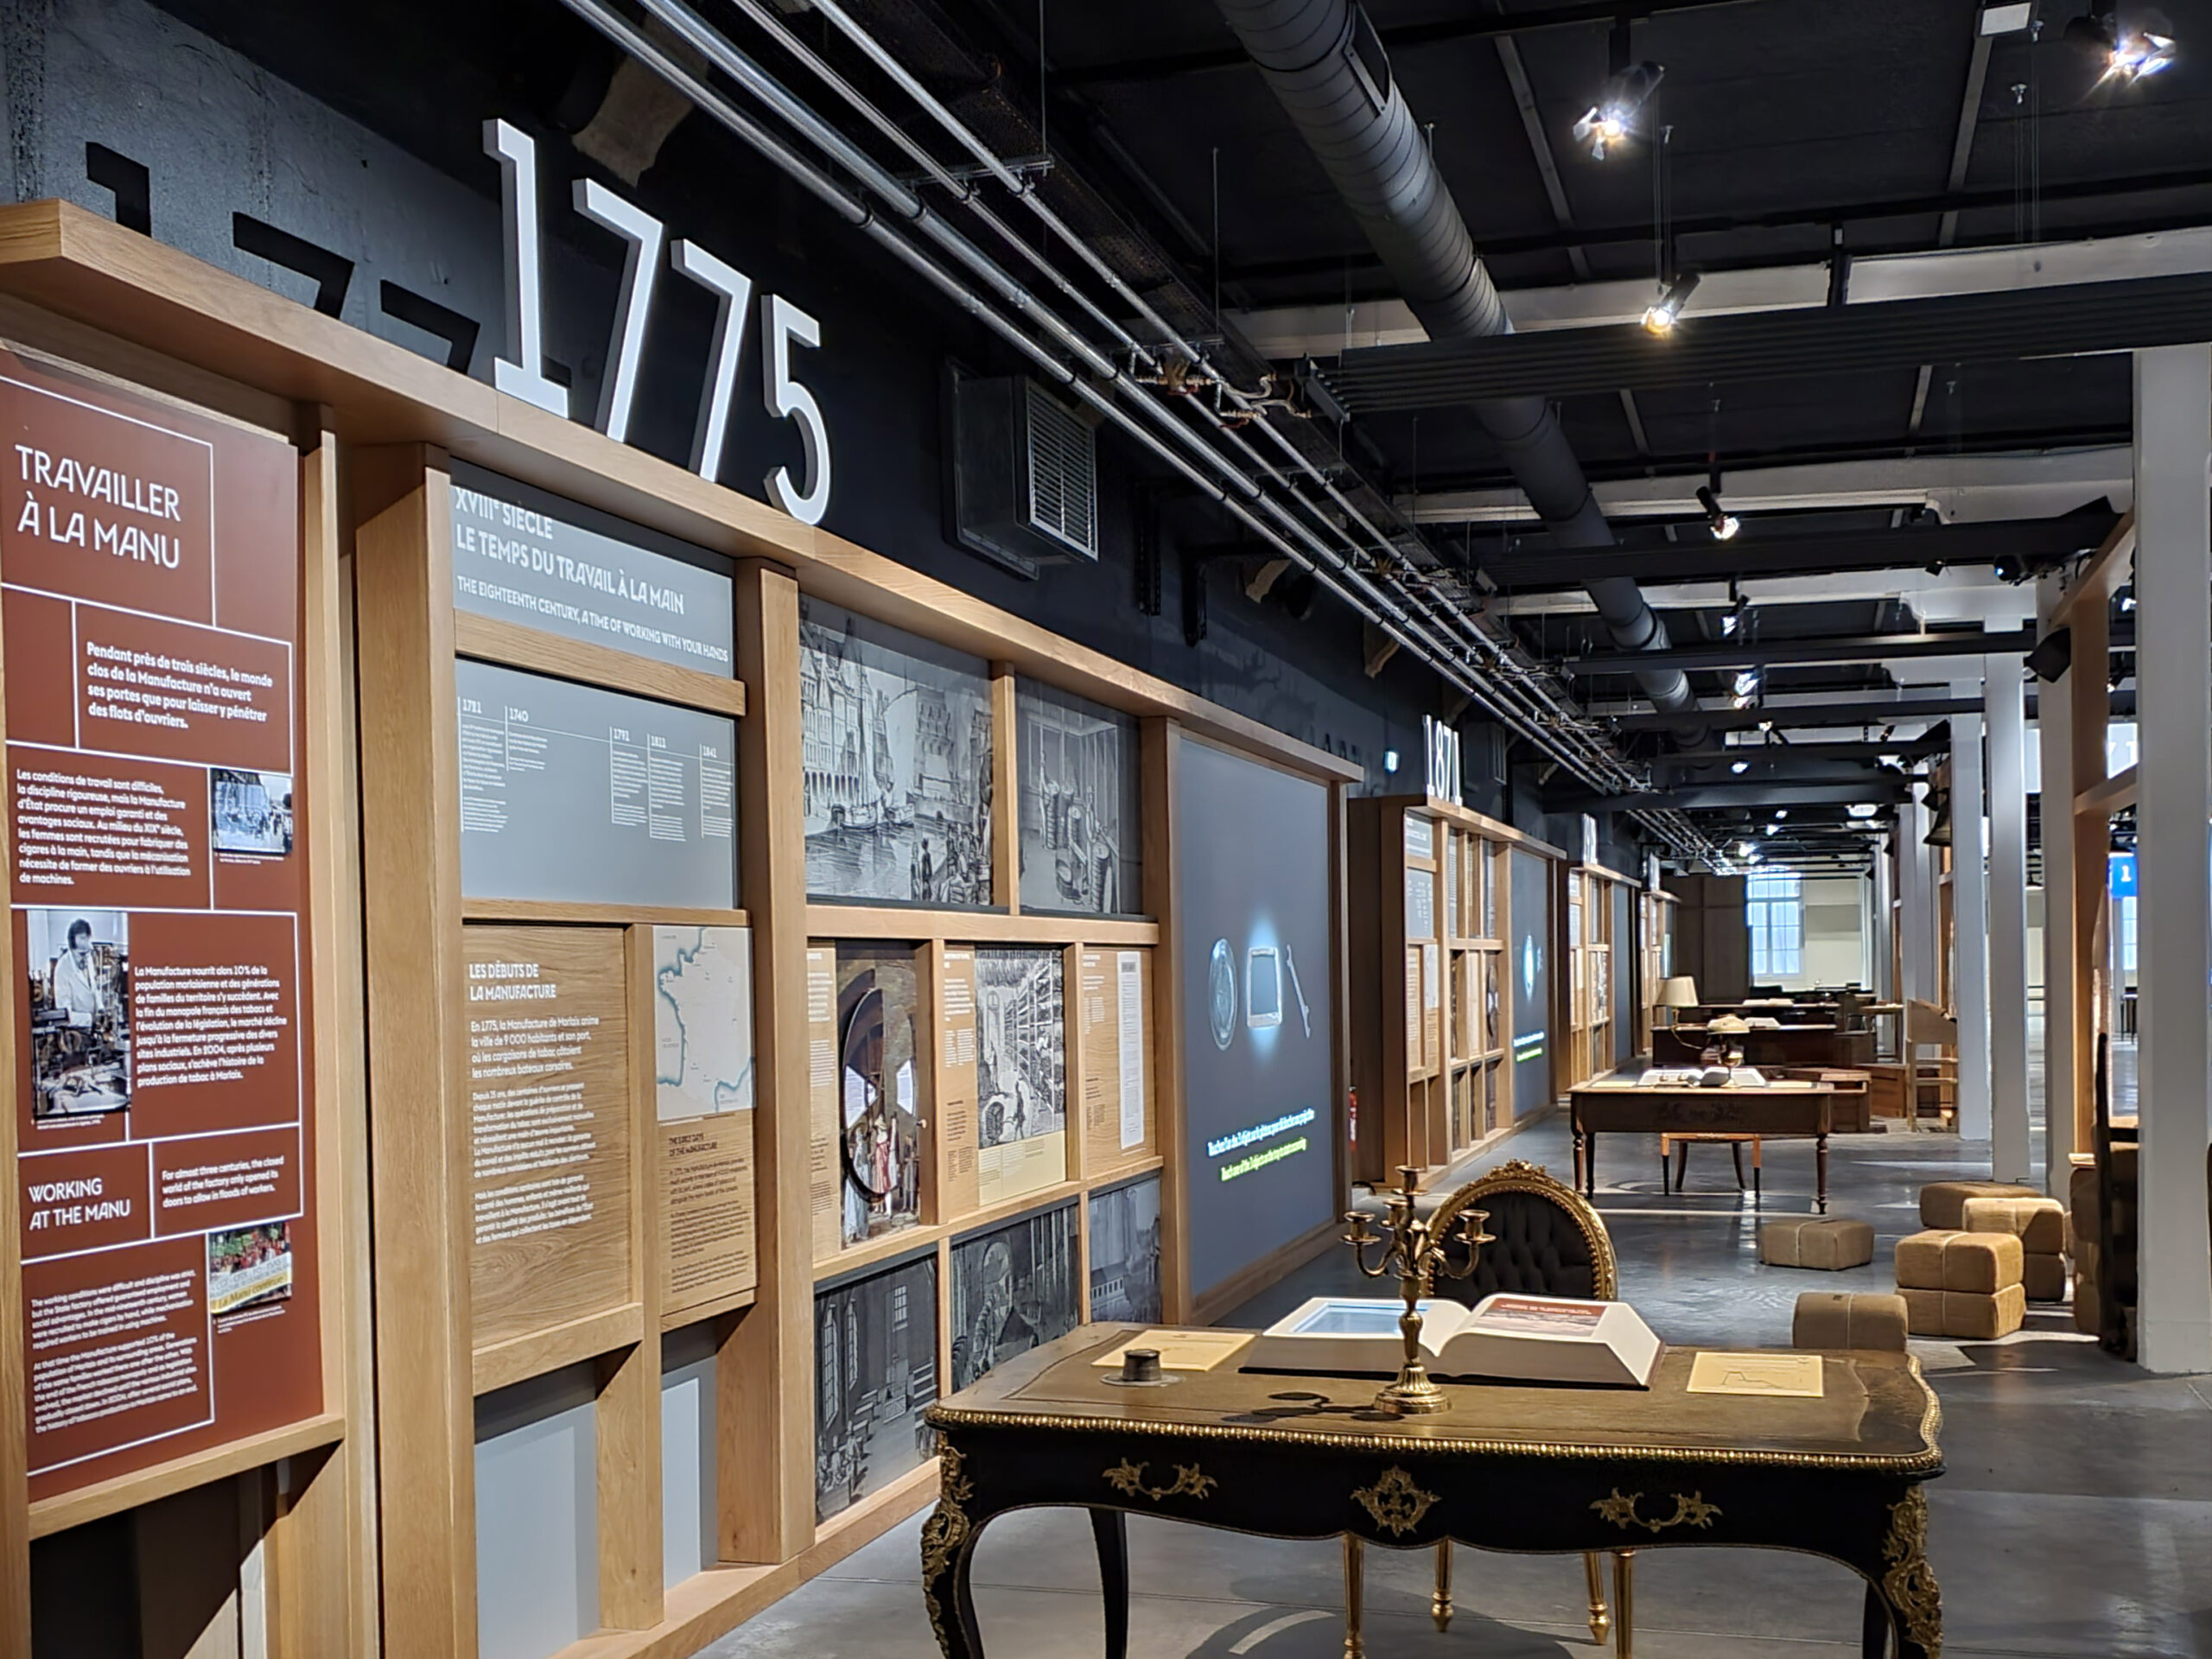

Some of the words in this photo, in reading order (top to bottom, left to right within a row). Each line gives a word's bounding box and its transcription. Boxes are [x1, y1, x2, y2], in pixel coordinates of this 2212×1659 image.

[483, 118, 831, 525] 1775
[15, 444, 181, 521] TRAVAILLER
[17, 490, 39, 535] À
[49, 506, 84, 546] LA
[94, 518, 179, 568] MANU
[457, 524, 475, 551] LE
[478, 531, 528, 567] TEMPS
[531, 547, 553, 575] DU
[556, 555, 615, 594] TRAVAIL
[618, 569, 627, 598] À
[630, 578, 647, 603] LA
[650, 585, 683, 614] MAIN
[86, 641, 131, 662] Pendant
[133, 652, 156, 666] près
[156, 655, 170, 669] de
[171, 658, 194, 673] trois
[194, 662, 229, 681] siècles,
[230, 667, 239, 681] le
[240, 672, 272, 687] monde
[87, 662, 109, 677] clos
[110, 665, 124, 680] de
[125, 668, 136, 682] la
[137, 671, 202, 693] Manufacture
[203, 682, 219, 696] n'a
[220, 687, 251, 702] ouvert
[87, 684, 105, 696] ses
[106, 688, 140, 702] portes
[142, 693, 162, 706] que
[162, 696, 187, 709] pour
[188, 697, 219, 714] laisser
[218, 705, 226, 717] y
[226, 704, 267, 721] pénétrer
[88, 702, 108, 717] des
[109, 704, 133, 721] flots
[134, 709, 188, 728] d'ouvriers.
[1422, 715, 1462, 806] 1871
[469, 963, 486, 978] LES
[487, 960, 524, 978] DÉBUTS
[525, 963, 538, 977] DE
[469, 985, 483, 1001] LA
[485, 983, 556, 1000] MANUFACTURE
[29, 1177, 102, 1202] WORKING
[29, 1210, 50, 1230] AT
[52, 1205, 81, 1225] THE
[85, 1198, 130, 1221] MANU
